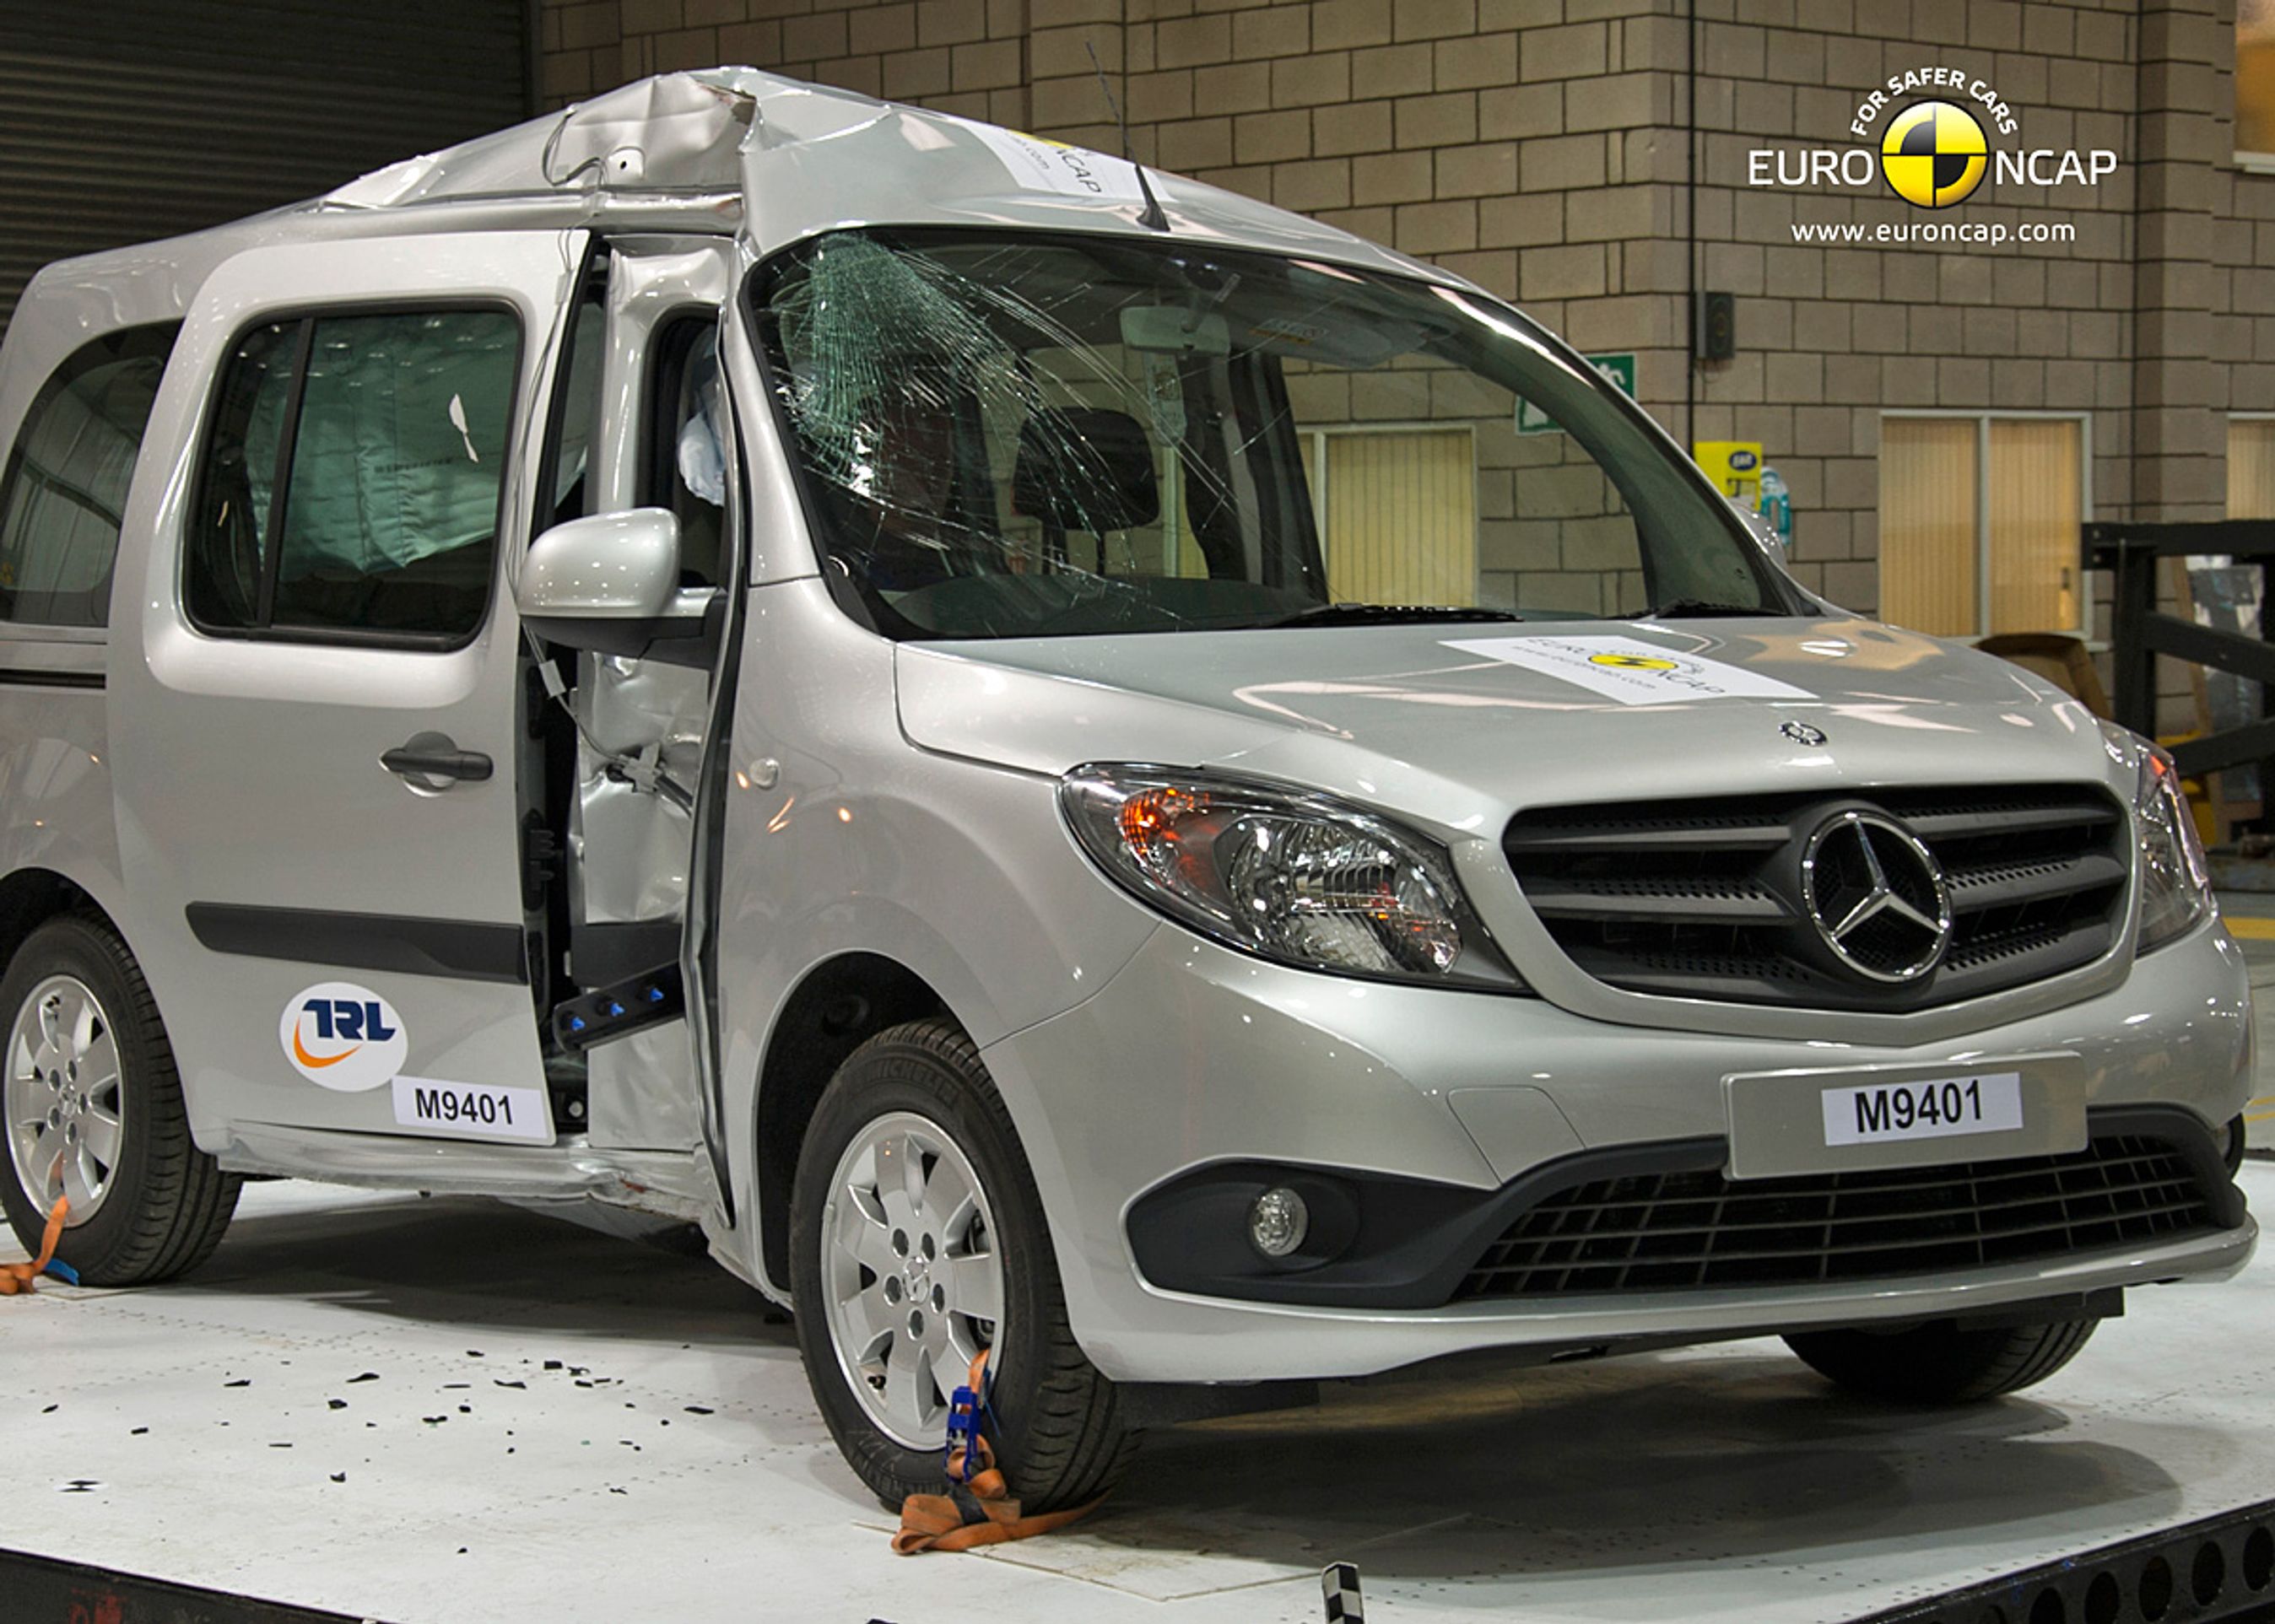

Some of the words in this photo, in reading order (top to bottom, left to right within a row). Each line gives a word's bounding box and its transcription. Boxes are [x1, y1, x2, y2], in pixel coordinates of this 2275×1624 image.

[301, 999, 397, 1042] TRL
[414, 1087, 512, 1125] M9401
[1854, 1079, 1982, 1133] M9401
